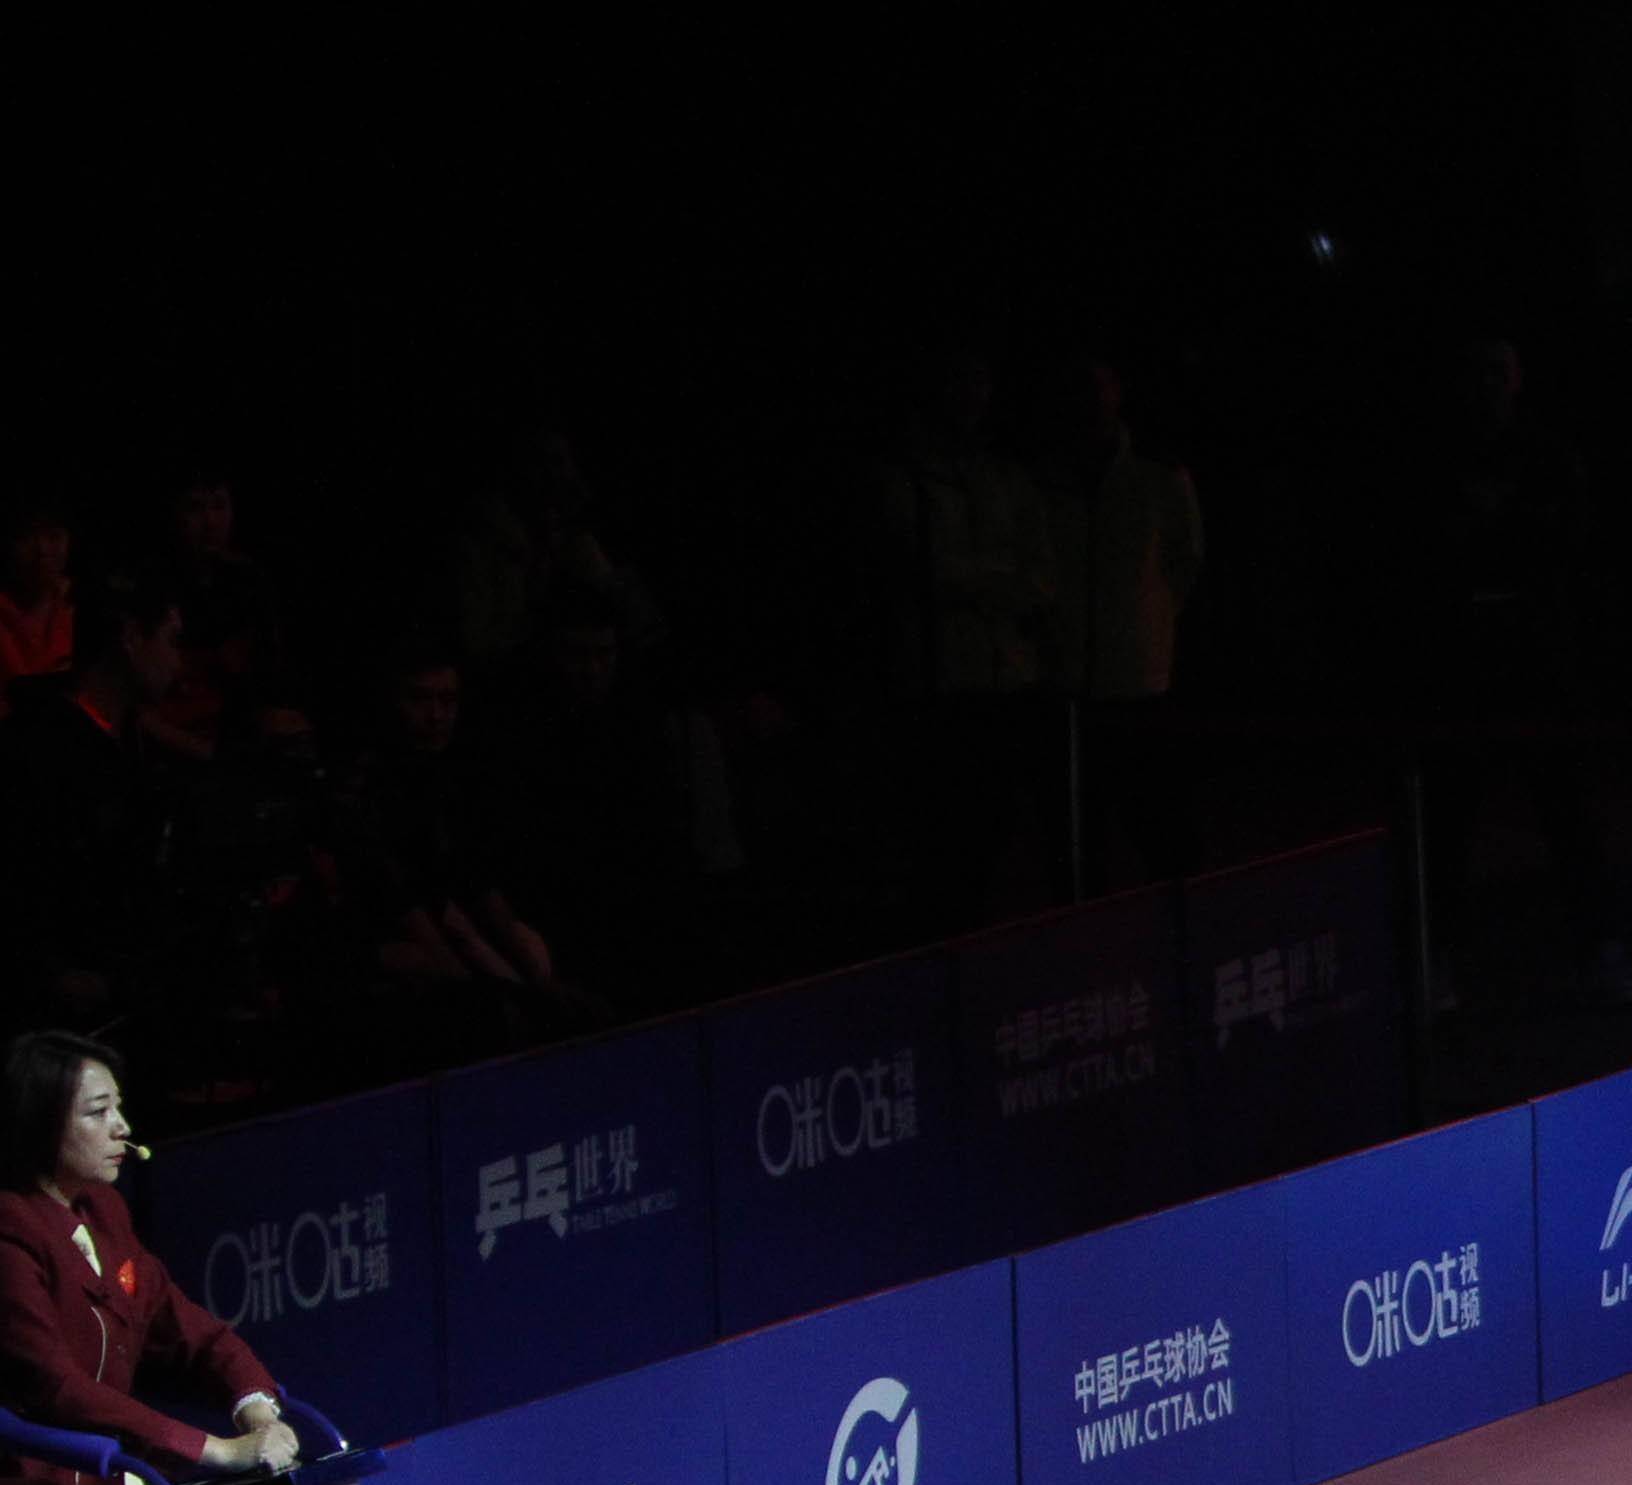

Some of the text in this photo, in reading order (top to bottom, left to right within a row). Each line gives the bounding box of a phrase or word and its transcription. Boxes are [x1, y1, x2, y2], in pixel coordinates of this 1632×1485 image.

[1074, 1318, 1231, 1414] 中国乒乓球协会
[1076, 1377, 1233, 1464] WWW.CTTA.CN
